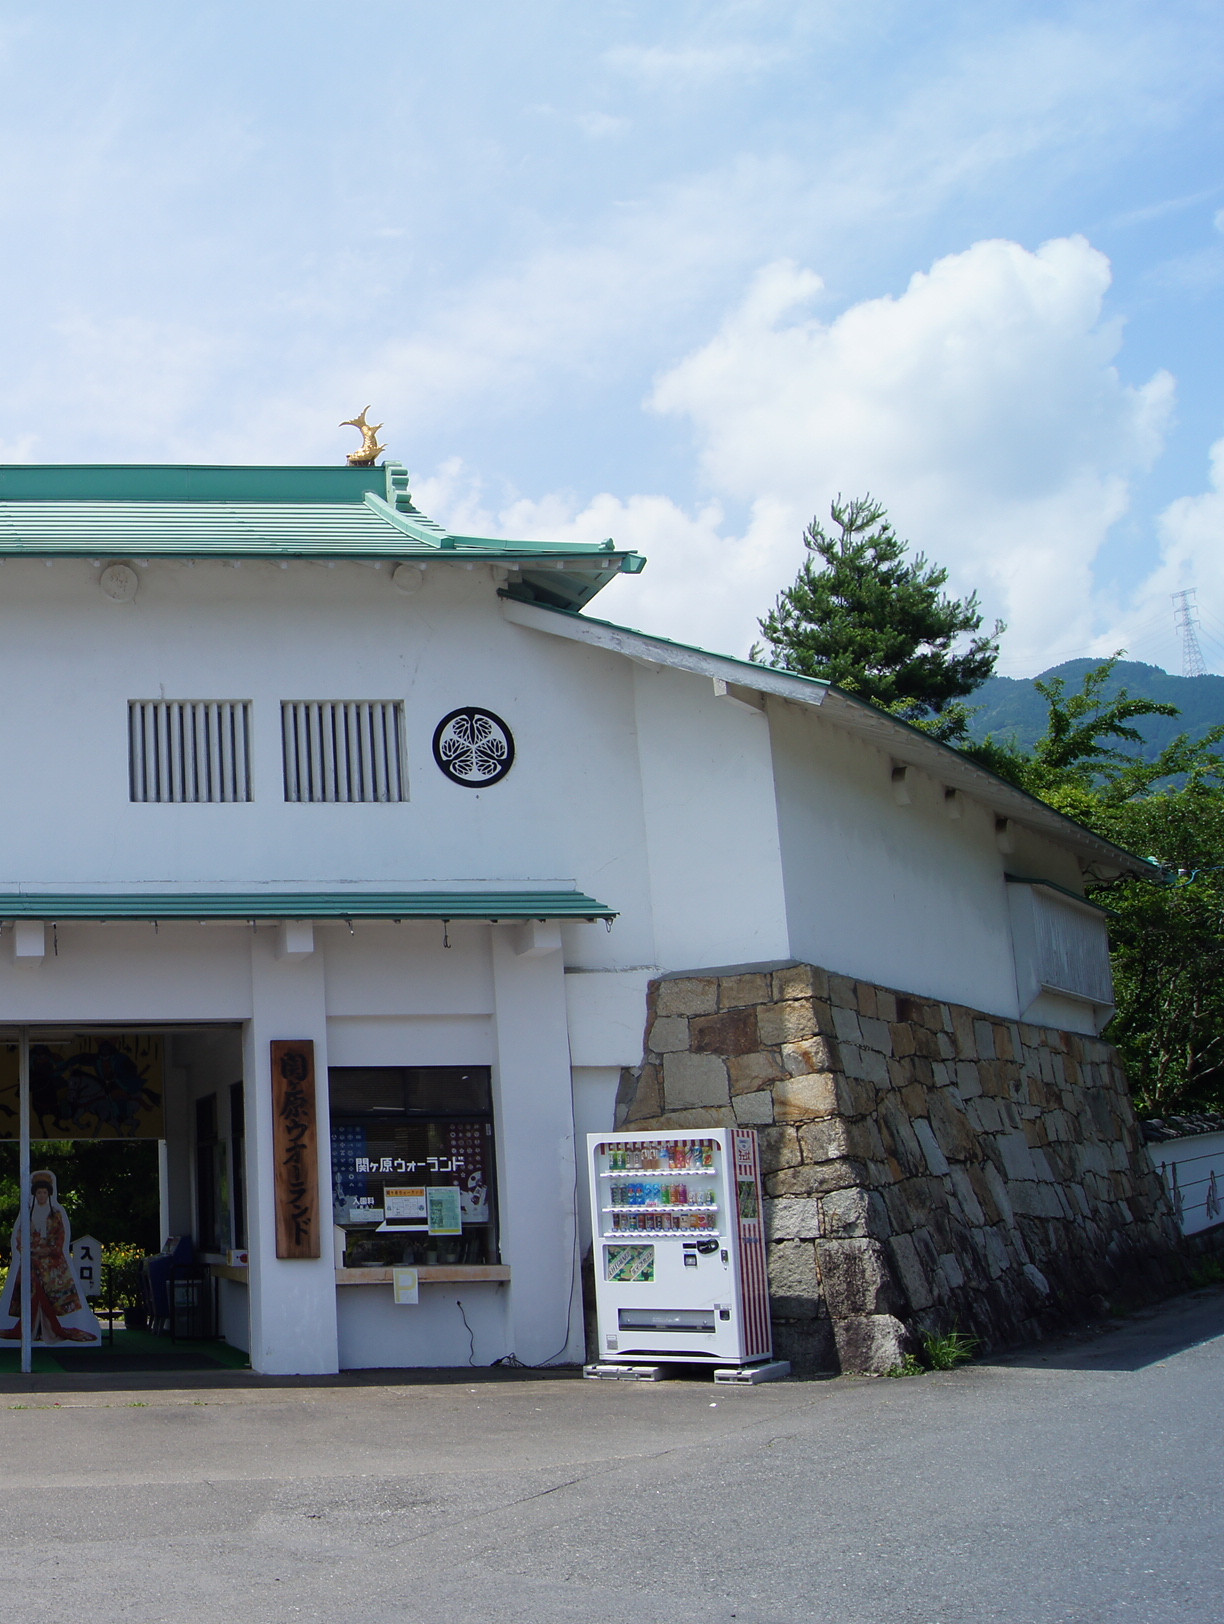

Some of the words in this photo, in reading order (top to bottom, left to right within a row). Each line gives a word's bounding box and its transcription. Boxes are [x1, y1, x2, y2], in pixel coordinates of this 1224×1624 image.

[355, 1156, 465, 1173] 関ヶ原ウォーランド
[79, 1246, 94, 1280] 入口
